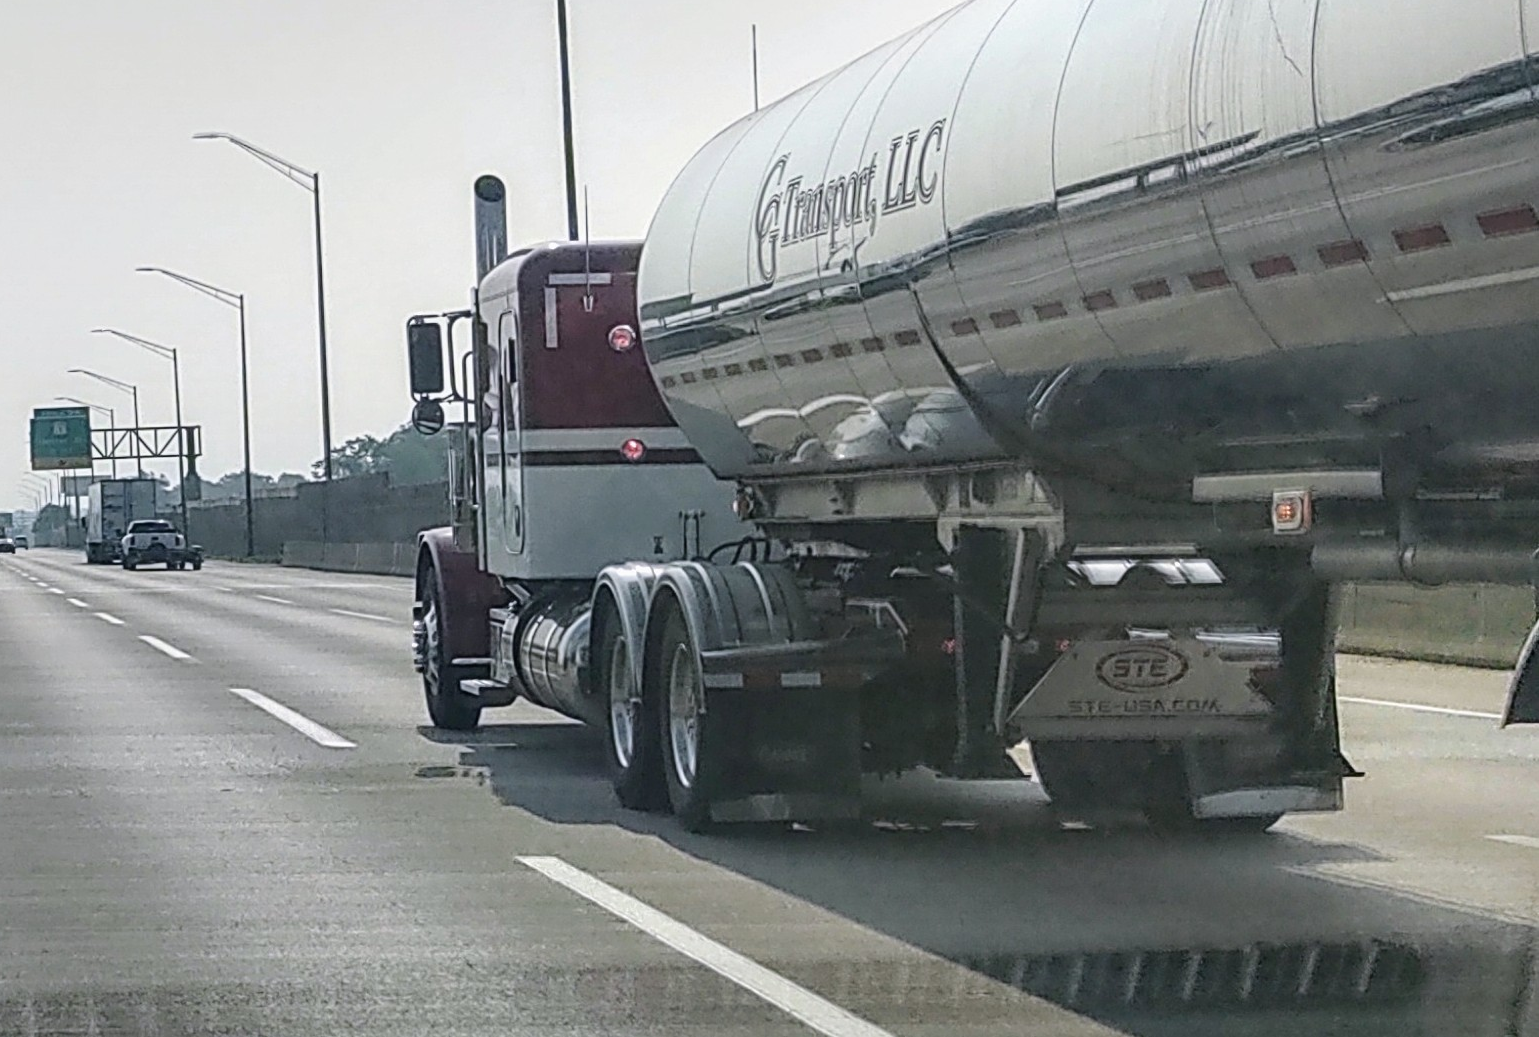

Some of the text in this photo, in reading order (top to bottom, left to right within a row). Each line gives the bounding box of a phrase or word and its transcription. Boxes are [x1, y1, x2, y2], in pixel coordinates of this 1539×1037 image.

[780, 151, 878, 252] Transport,
[882, 117, 948, 216] LLC
[1113, 659, 1168, 678] STE
[1068, 699, 1222, 713] STE-USA.COM
